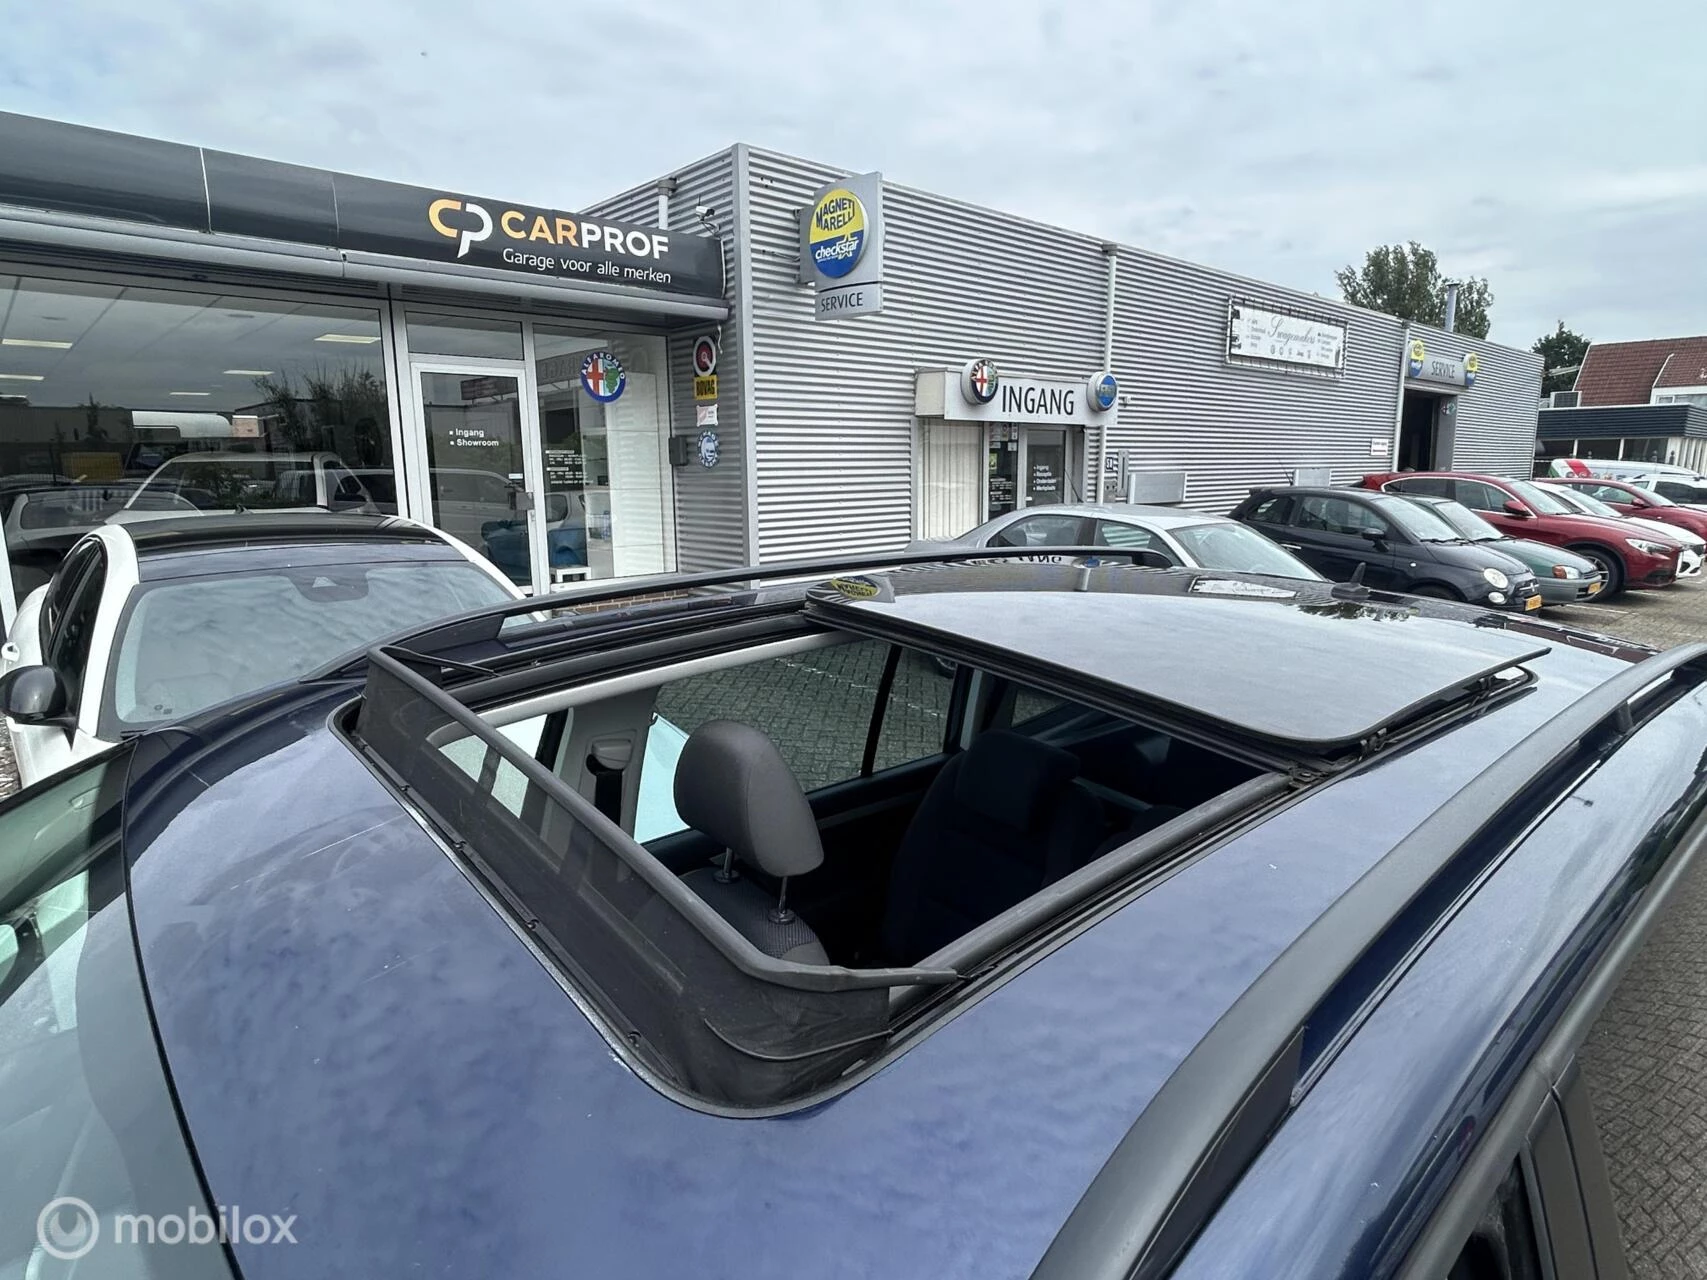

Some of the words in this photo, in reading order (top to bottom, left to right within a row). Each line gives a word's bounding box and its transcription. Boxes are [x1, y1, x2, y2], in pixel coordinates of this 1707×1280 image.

[501, 211, 669, 259] CARPROF
[815, 238, 859, 260] checkstar
[503, 248, 555, 271] Garage
[560, 256, 593, 273] voor
[597, 261, 620, 279] alle
[624, 266, 671, 284] merken
[821, 292, 863, 312] SERVICE
[581, 353, 598, 375] ALFA
[1431, 360, 1456, 379] SERVICE
[1002, 385, 1075, 416] INGANG
[455, 428, 485, 438] Ingang
[456, 438, 499, 446] Showroom
